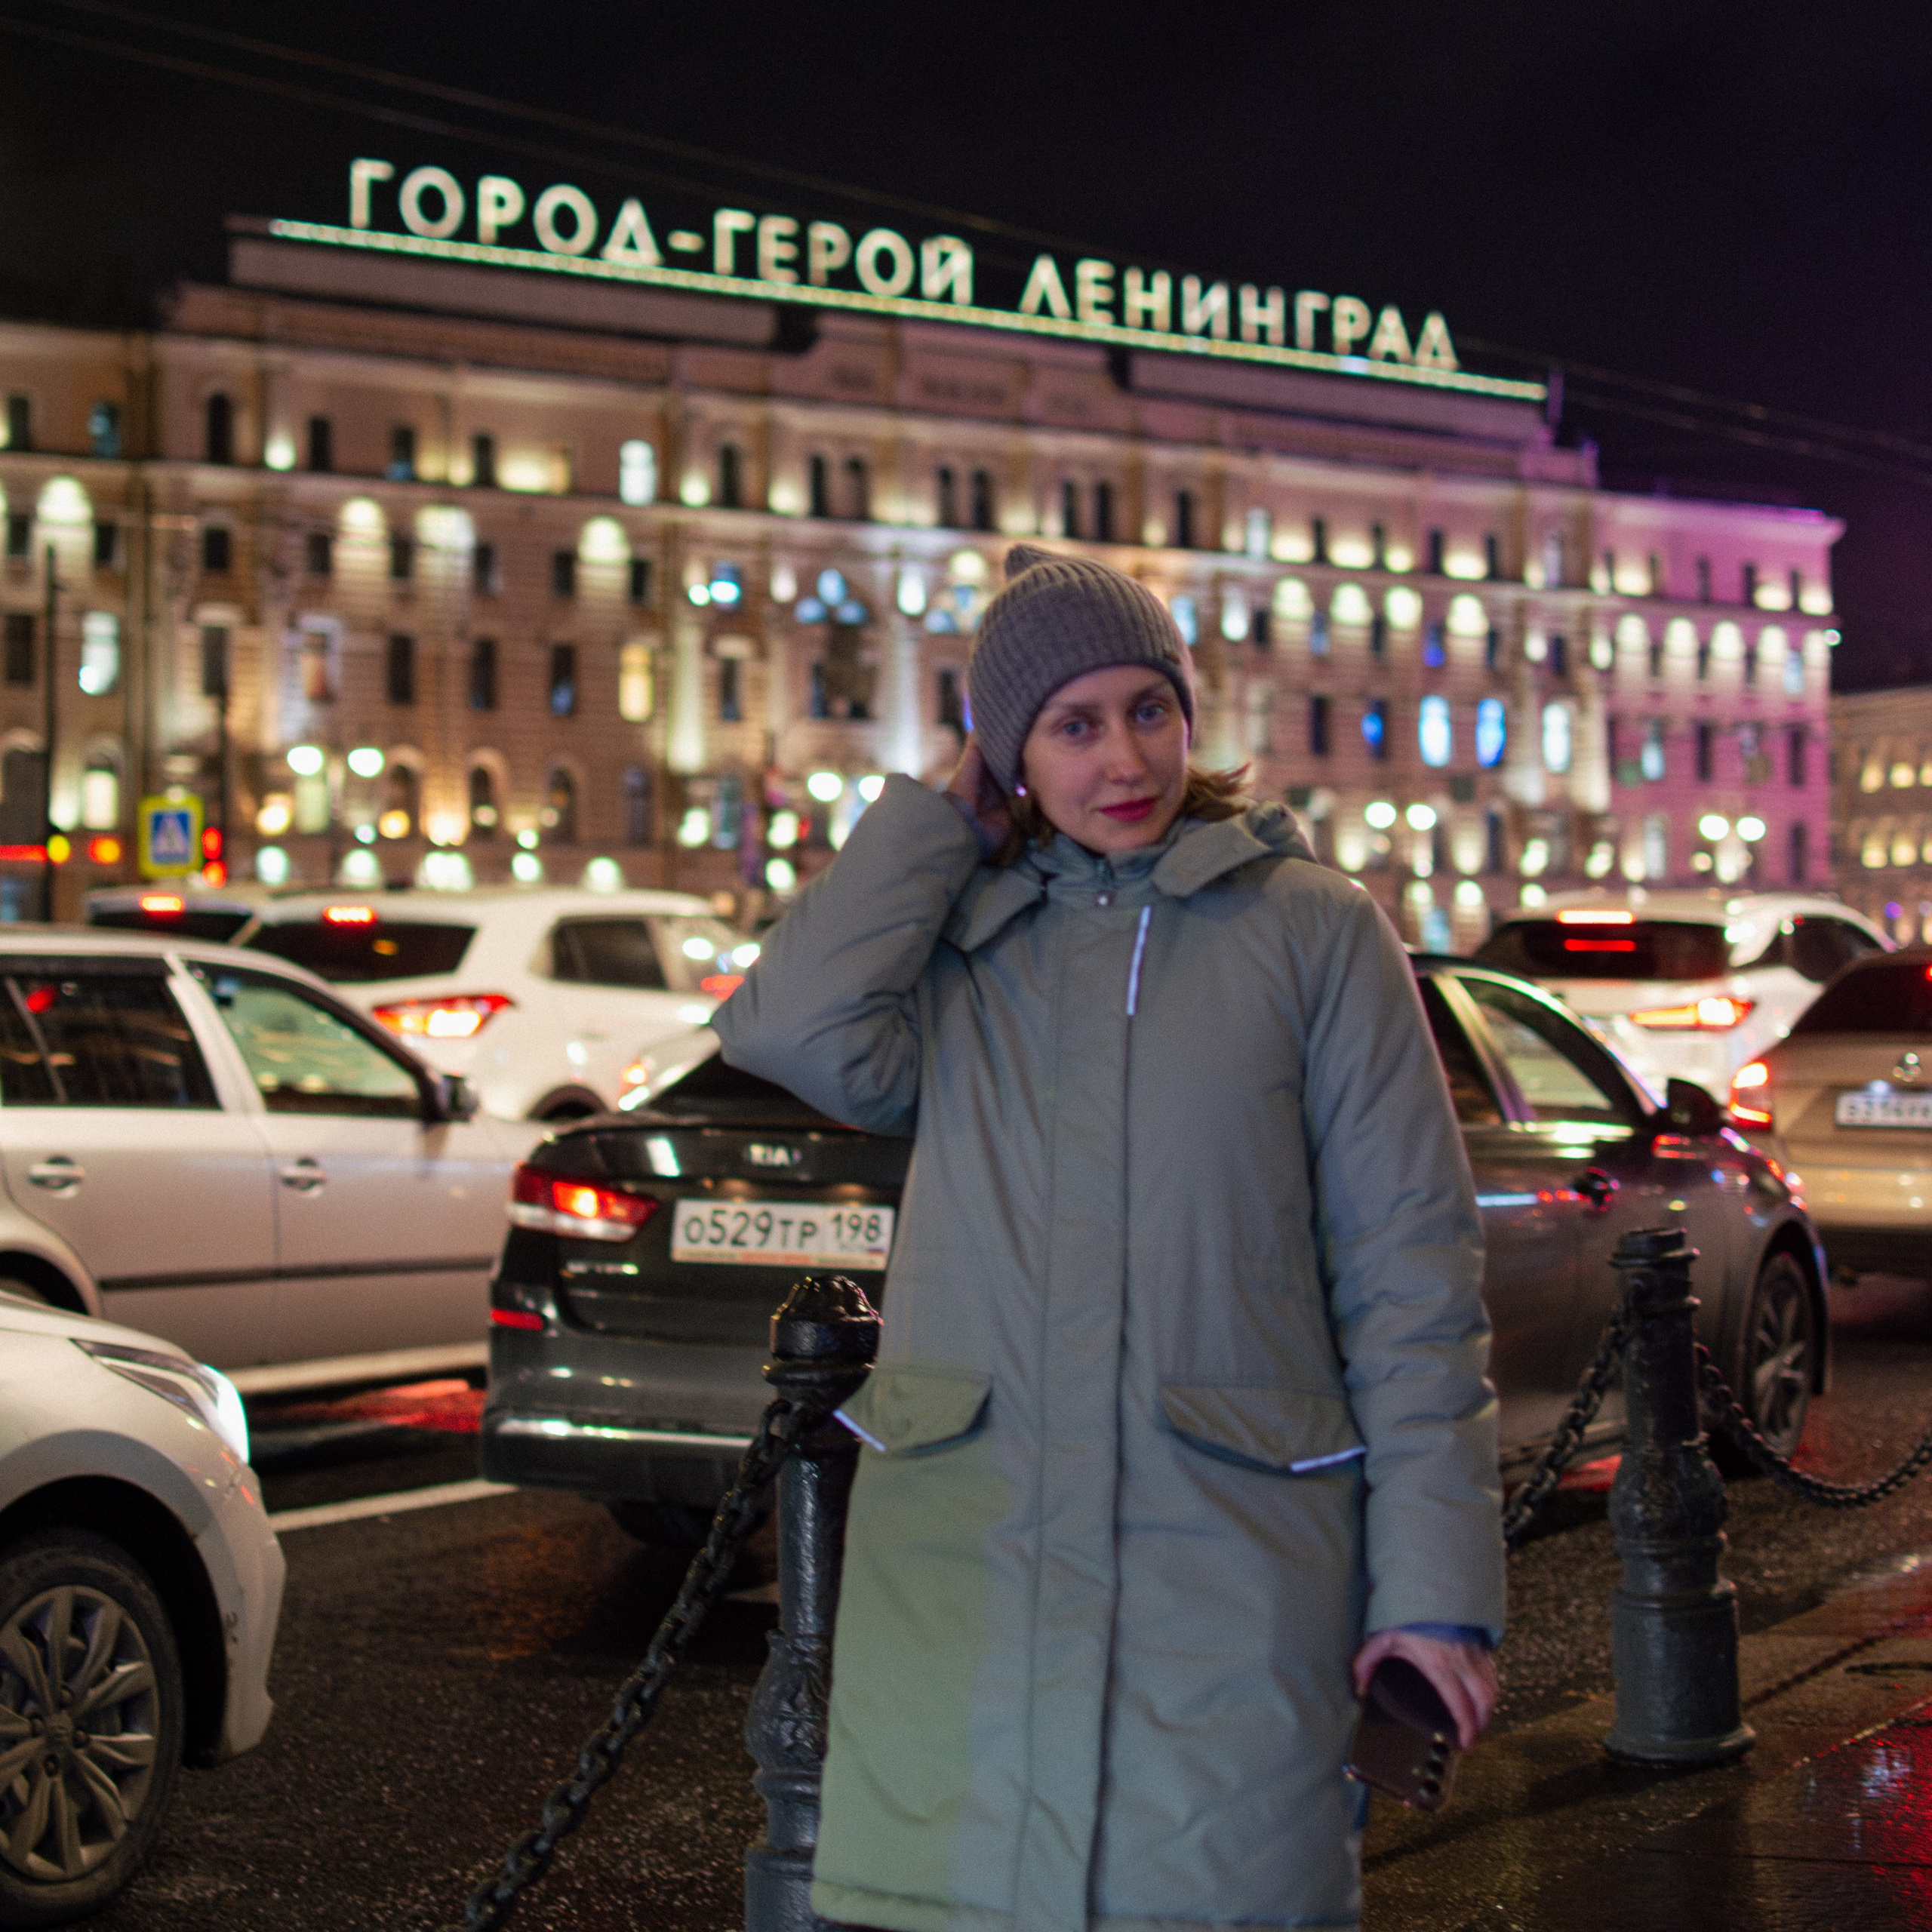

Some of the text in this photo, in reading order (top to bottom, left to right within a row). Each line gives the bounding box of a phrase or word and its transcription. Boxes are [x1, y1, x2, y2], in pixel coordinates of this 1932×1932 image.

[349, 157, 1460, 371] ГОРОД-ГЕРОЙ ЛЕНИНГРАД
[832, 1213, 881, 1242] 198
